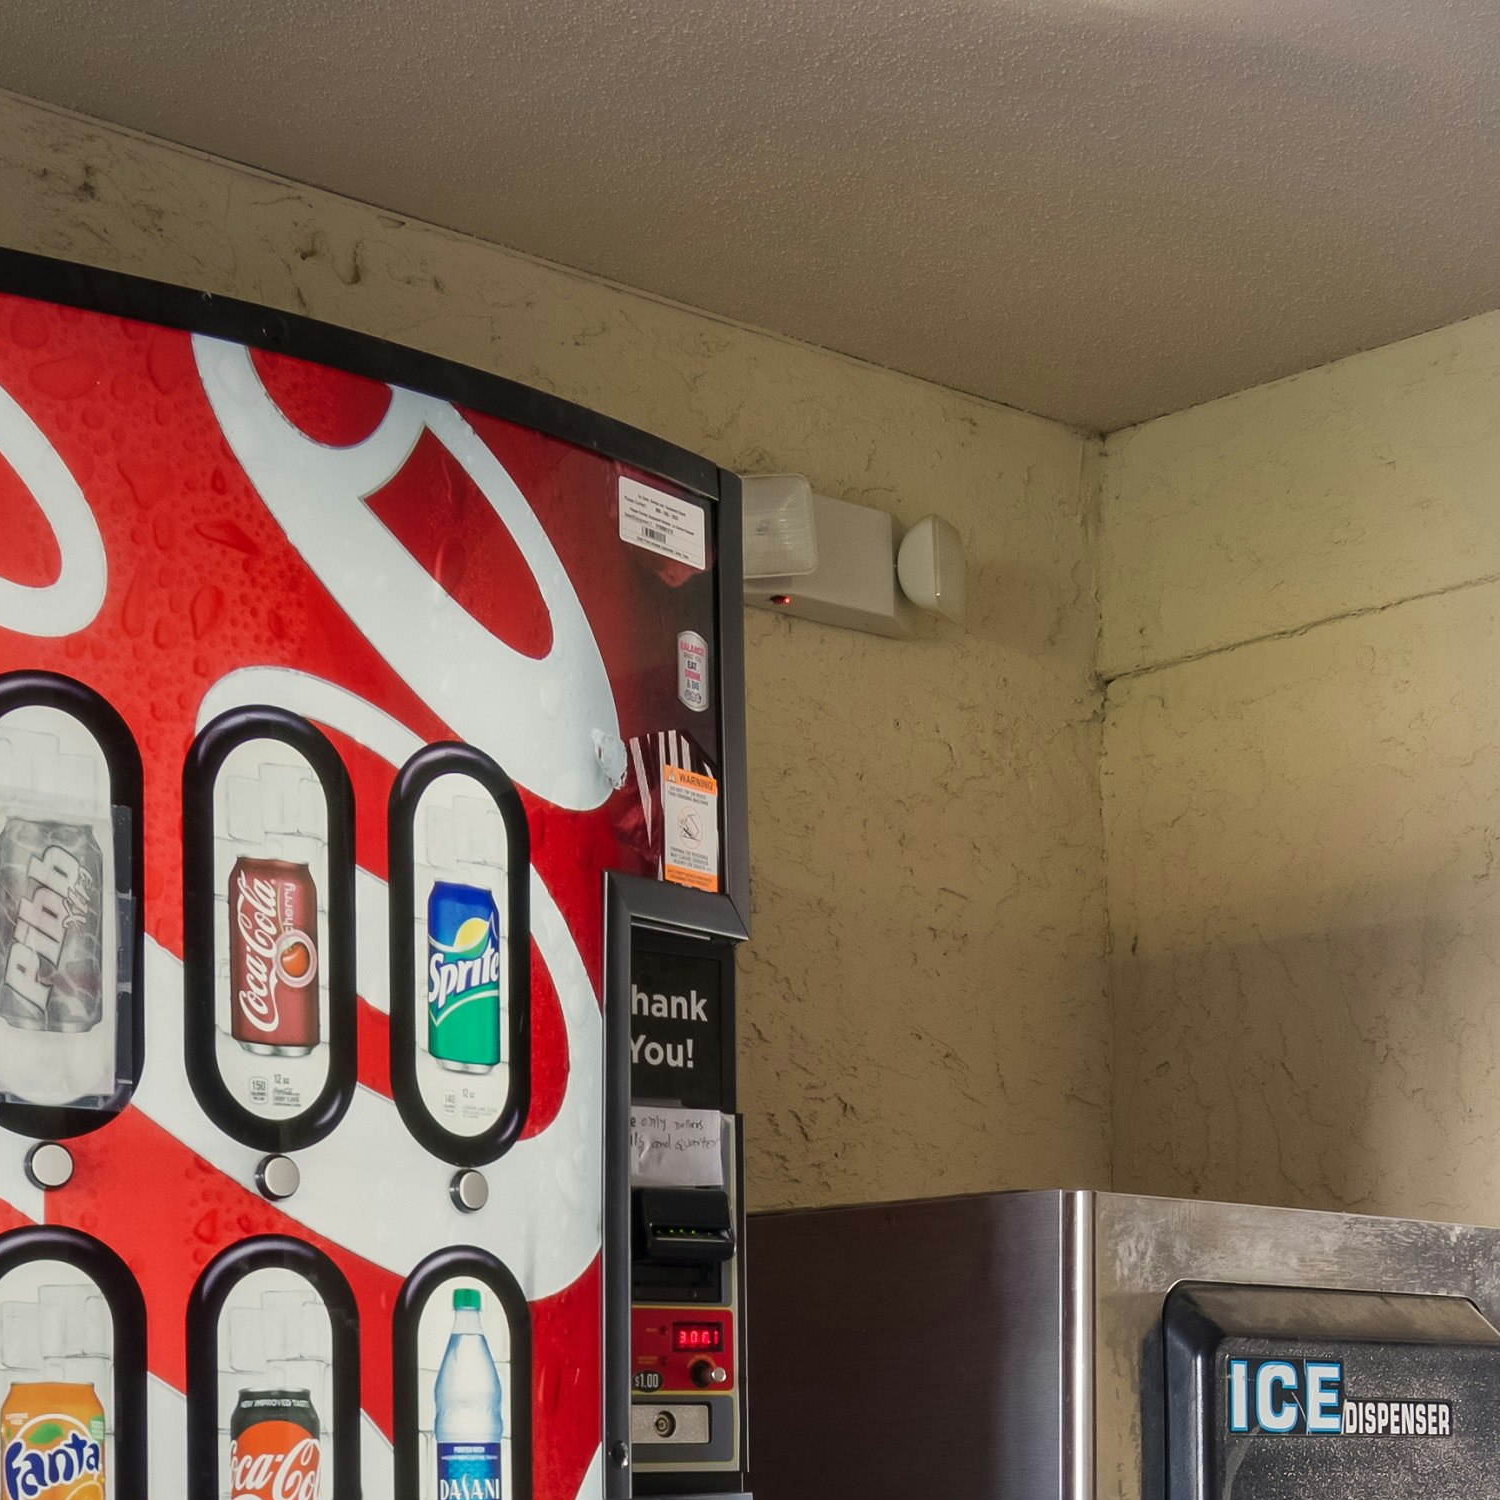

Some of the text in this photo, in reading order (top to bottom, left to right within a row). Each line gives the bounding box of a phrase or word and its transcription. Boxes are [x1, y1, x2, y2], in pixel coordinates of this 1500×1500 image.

[687, 660, 697, 670] EAT
[679, 772, 713, 791] WARNING
[284, 881, 297, 935] cherry
[237, 869, 280, 1033] Coca-Cola
[428, 937, 500, 1010] Sprite
[631, 984, 708, 1022] hank
[630, 1034, 694, 1069] You!
[251, 1080, 266, 1091] 150
[641, 1115, 667, 1132] only
[651, 1133, 672, 1149] and
[634, 1373, 660, 1389] $1.00
[1230, 1359, 1450, 1436] ICE DISPENSER
